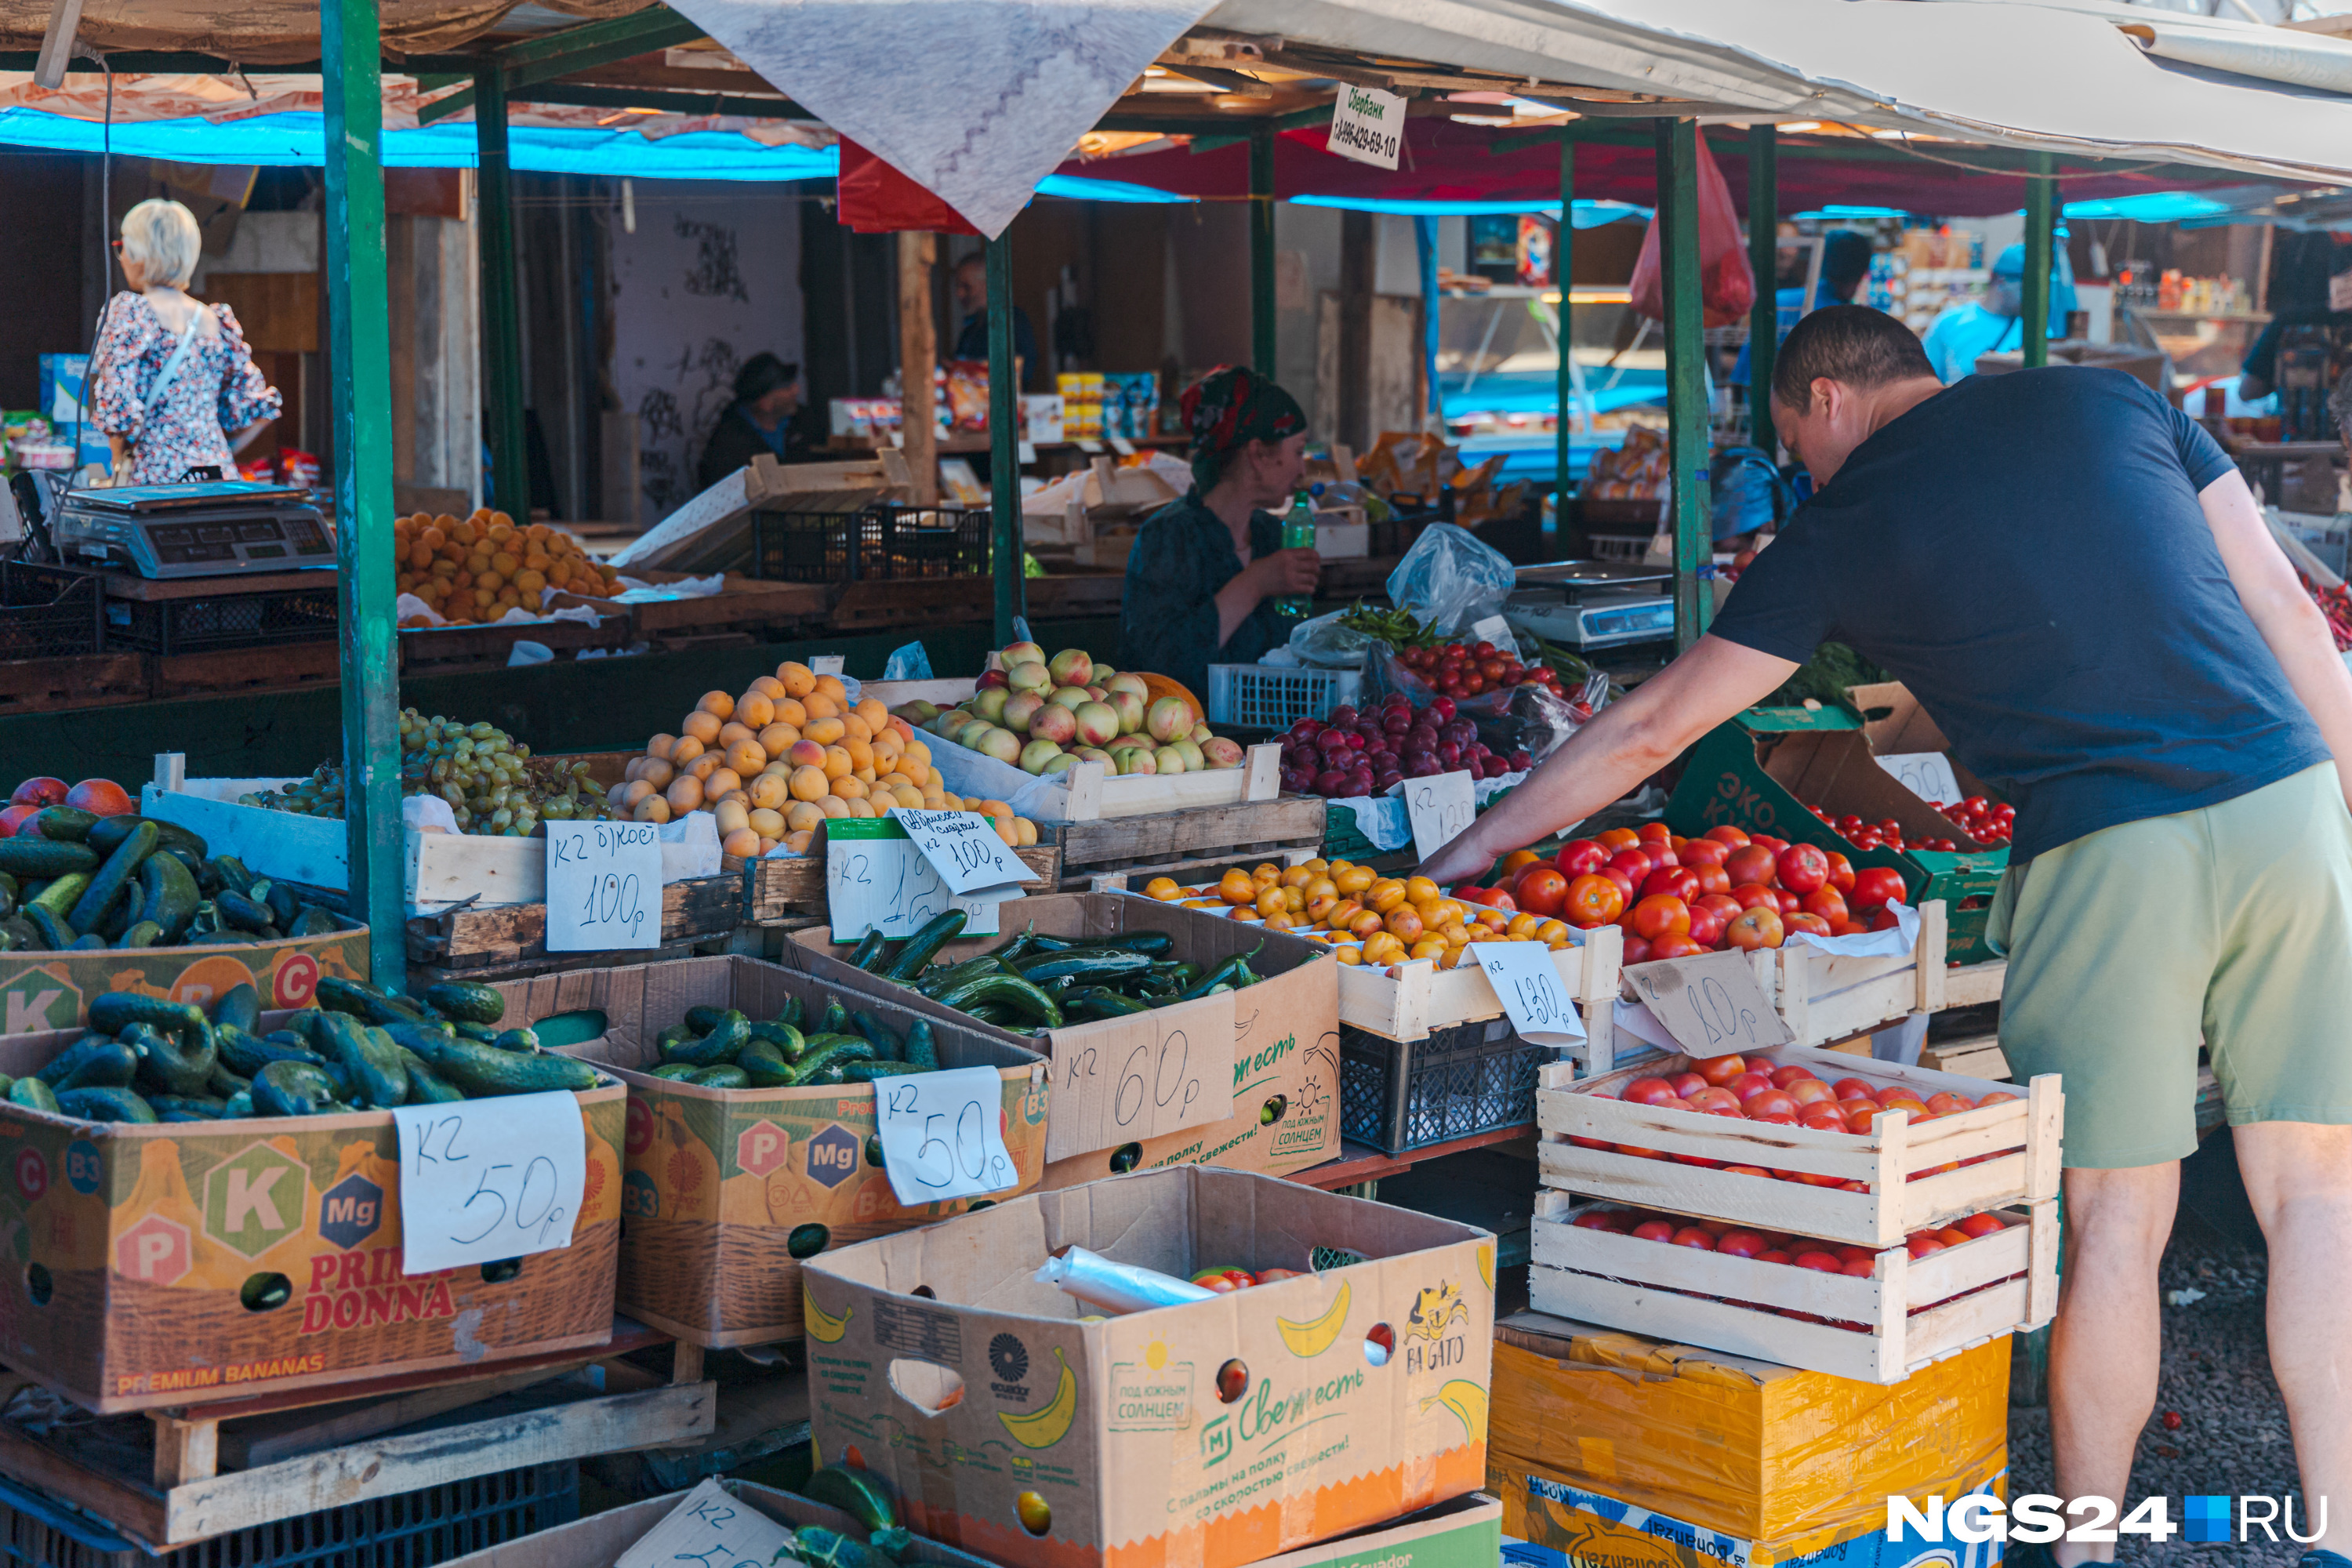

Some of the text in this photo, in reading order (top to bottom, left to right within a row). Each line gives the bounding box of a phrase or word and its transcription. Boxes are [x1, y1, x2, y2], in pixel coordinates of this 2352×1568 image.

[1348, 87, 1385, 120] Сбербанк
[283, 964, 309, 1000] C
[1234, 1032, 1295, 1088] жесть
[1027, 1091, 1048, 1116] B3
[1279, 1127, 1322, 1145] СОЛНЦЕМ
[1282, 1114, 1324, 1130] ПОД ЮЖНЫМ
[753, 1133, 778, 1166] P
[813, 1143, 853, 1170] Mg
[1167, 1141, 1203, 1163] полку
[1200, 1123, 1258, 1165] свежести!
[21, 1156, 39, 1192] C
[71, 1152, 100, 1181] B3
[225, 1166, 289, 1233] K
[327, 1197, 375, 1228] Mg
[625, 1185, 657, 1218] B3
[138, 1232, 174, 1279] P
[308, 1247, 455, 1294] PRI
[299, 1279, 456, 1334] DONNA
[118, 1352, 325, 1396] PREMIUM BANANAS
[1120, 1385, 1186, 1398] ПОД ЮЖНЫМ
[1118, 1402, 1184, 1419] СОЛНЦЕМ
[1240, 1367, 1364, 1441] Свежесть
[1166, 1450, 1287, 1513] С пальмы на полку
[1196, 1434, 1349, 1519] со скоростью свежести!
[1648, 1519, 1728, 1567] Bonanza!
